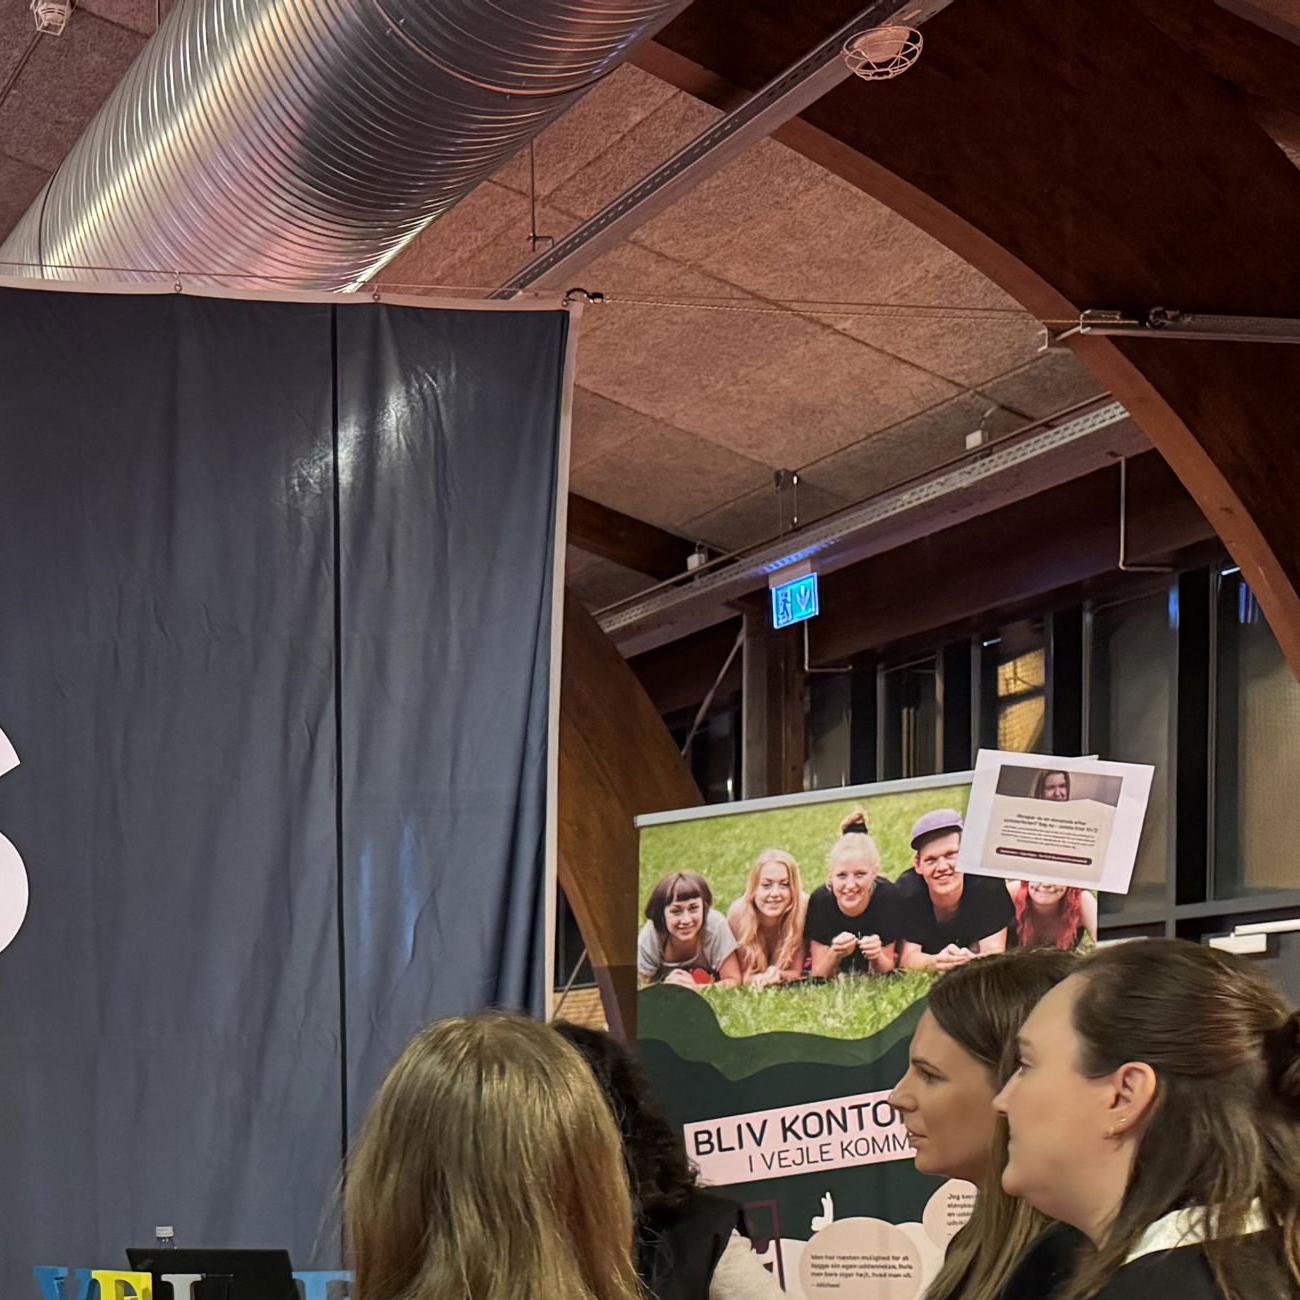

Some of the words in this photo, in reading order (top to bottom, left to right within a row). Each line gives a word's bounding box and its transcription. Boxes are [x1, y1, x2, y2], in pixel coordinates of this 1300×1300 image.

[694, 1118, 769, 1156] BLIV
[781, 1099, 905, 1143] KONTO
[748, 1154, 754, 1173] I
[760, 1142, 835, 1171] VEJLE
